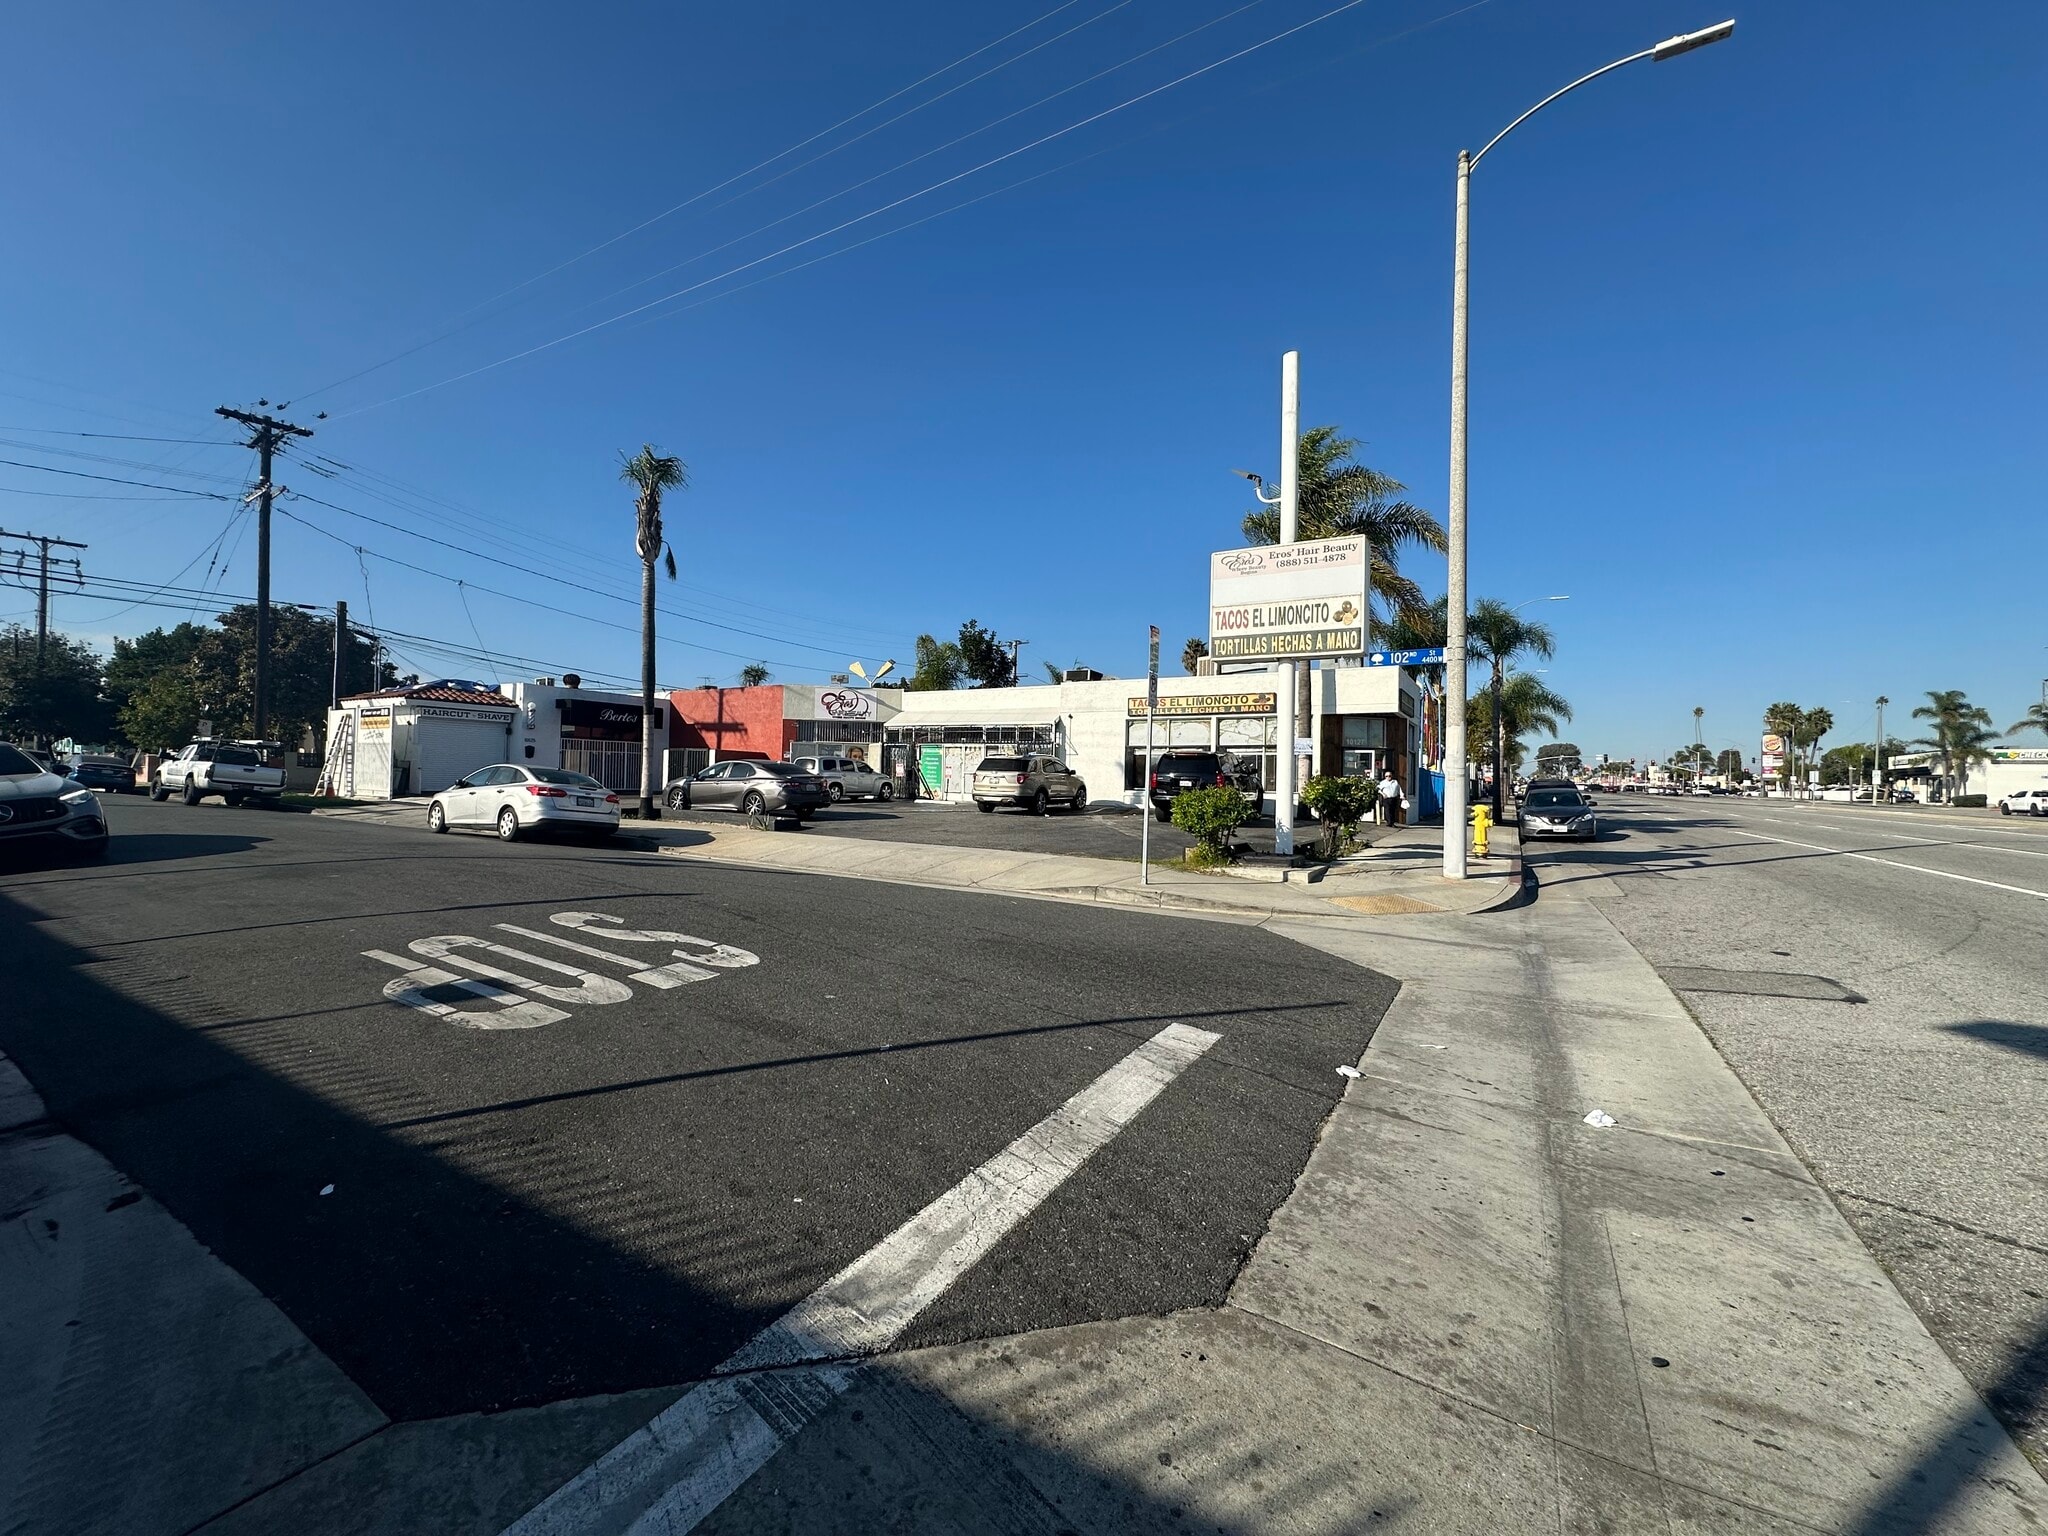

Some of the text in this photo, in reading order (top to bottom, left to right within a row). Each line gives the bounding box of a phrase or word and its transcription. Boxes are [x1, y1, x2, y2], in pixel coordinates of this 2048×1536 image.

[1297, 547, 1320, 556] Hair
[1323, 543, 1358, 553] Beauty
[1276, 553, 1346, 568] (888) 511-4878
[1215, 602, 1330, 630] TACOS EL LIMONCITO
[1214, 630, 1358, 656] TORTILLAS HECHAS A MANO
[1186, 695, 1249, 706] LIMONCITO
[423, 708, 510, 721] HAIRCUT SHAVE
[1240, 704, 1271, 712] MANO
[382, 911, 761, 1030] STOP
